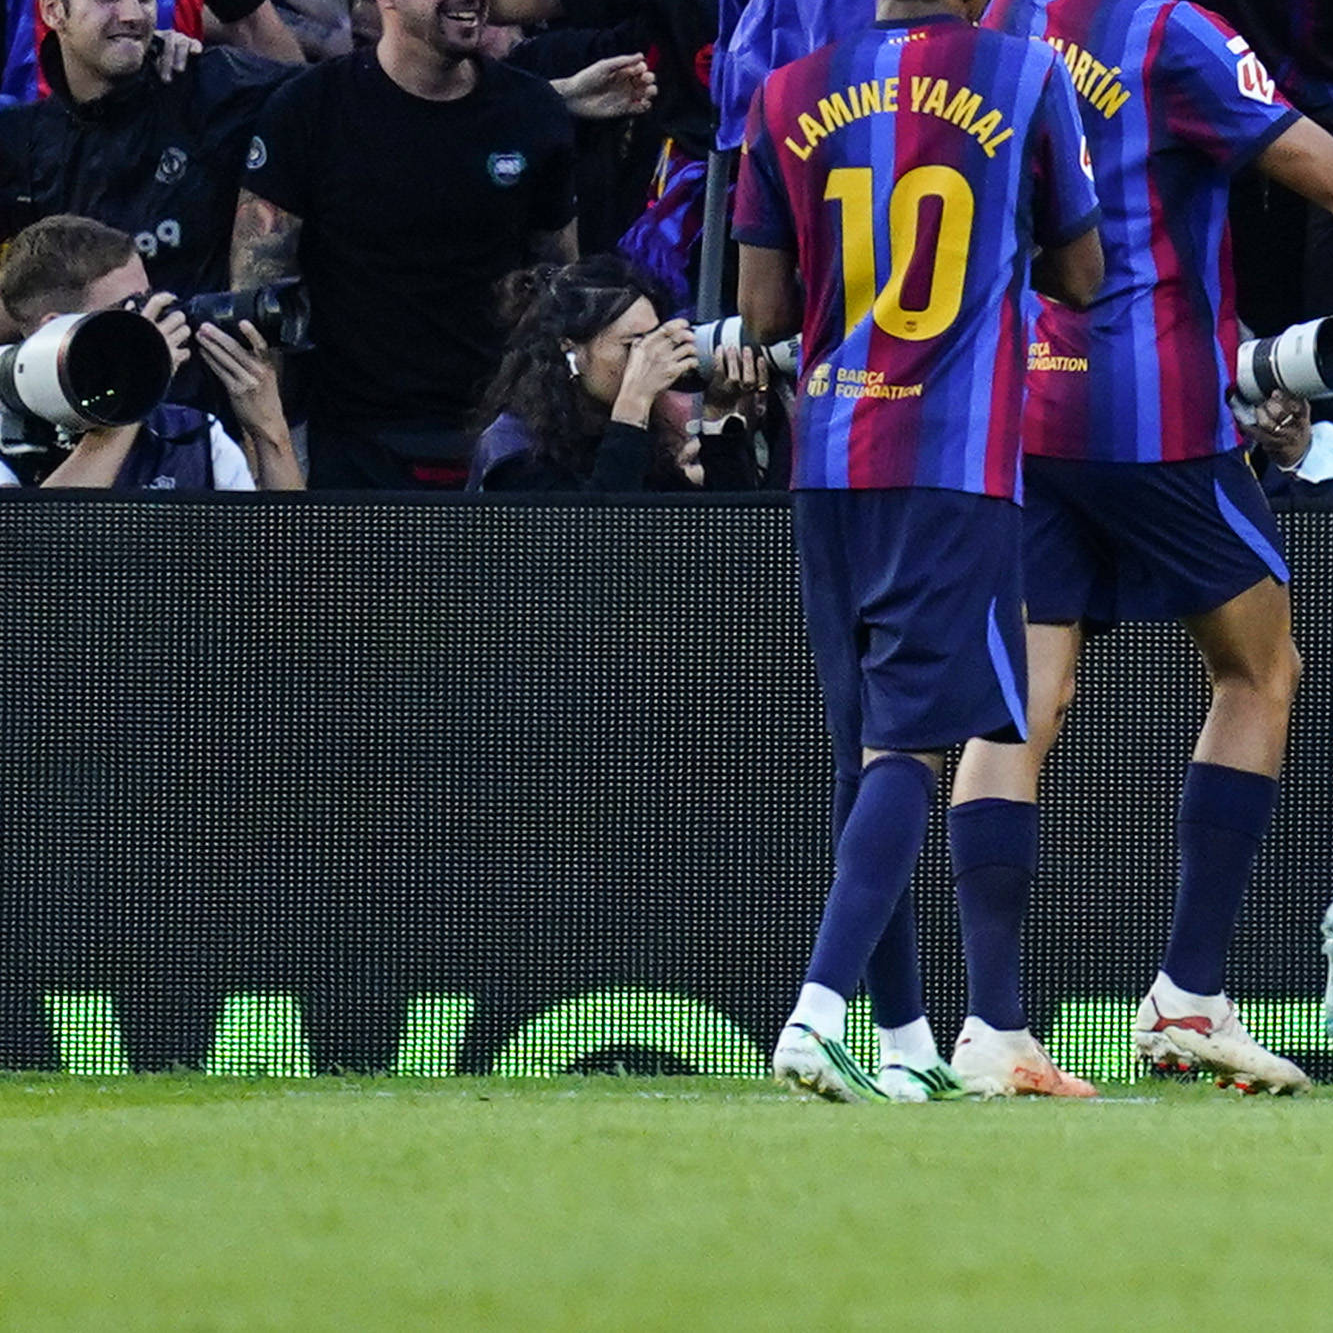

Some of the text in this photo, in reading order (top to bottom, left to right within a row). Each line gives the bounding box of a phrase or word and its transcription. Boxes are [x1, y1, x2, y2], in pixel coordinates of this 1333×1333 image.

[784, 77, 1015, 161] LAMINE YAMAL
[823, 165, 975, 341] 10
[835, 383, 923, 401] FOUNDATION
[836, 367, 885, 385] BARÇA
